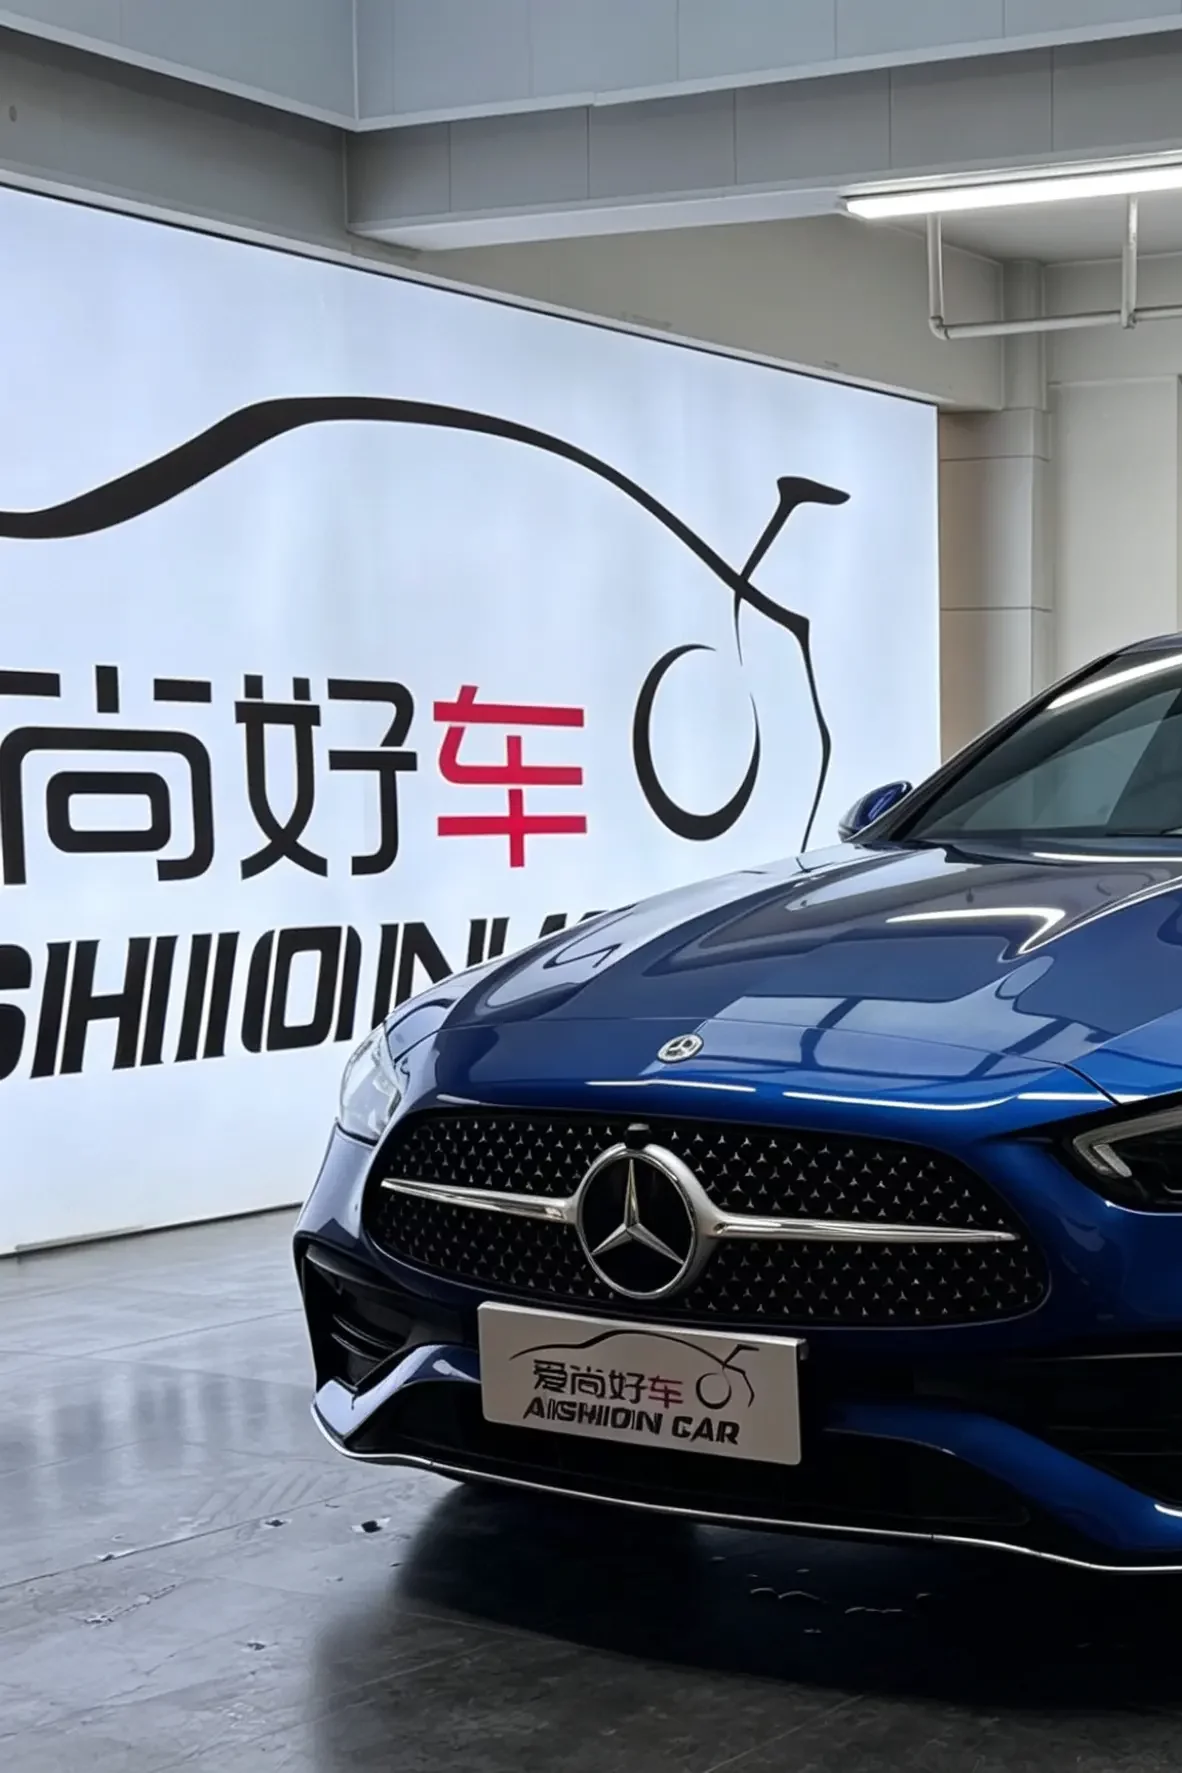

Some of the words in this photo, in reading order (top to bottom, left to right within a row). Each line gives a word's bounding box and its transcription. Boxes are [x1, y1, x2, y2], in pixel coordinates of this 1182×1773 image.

[533, 1359, 684, 1409] 爱尚好车
[671, 1415, 741, 1446] CAR
